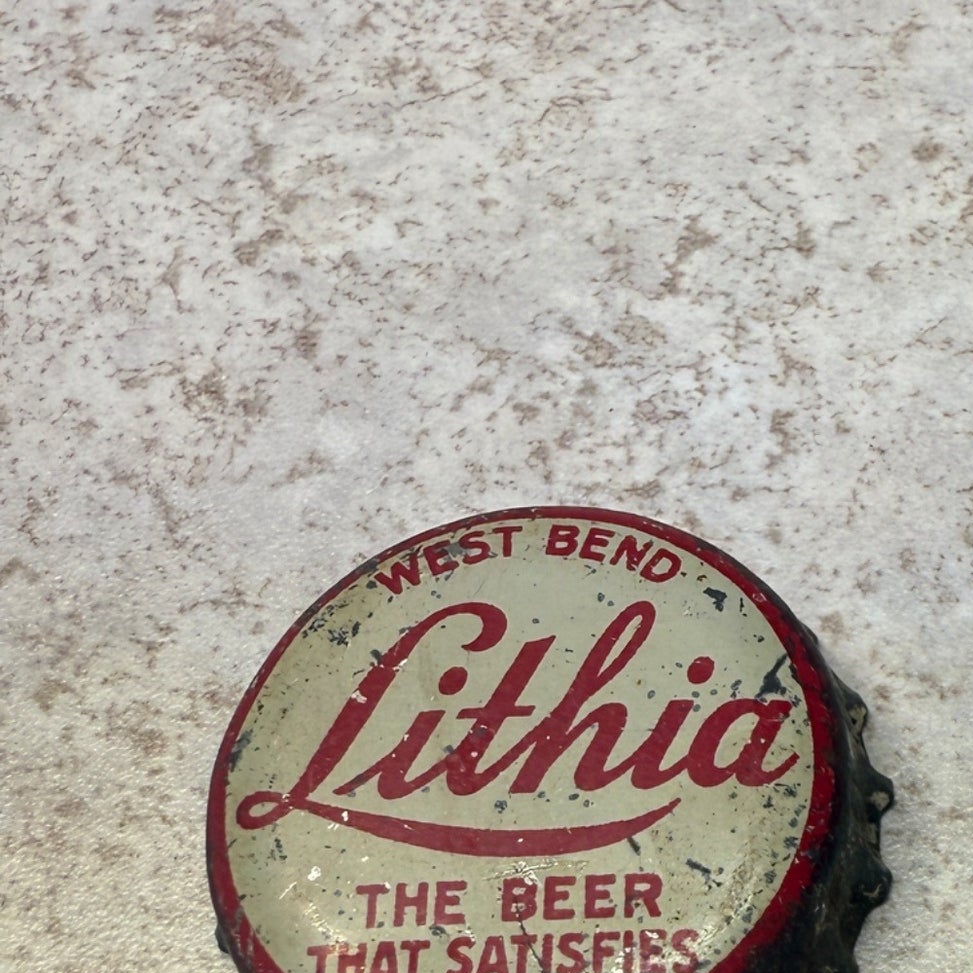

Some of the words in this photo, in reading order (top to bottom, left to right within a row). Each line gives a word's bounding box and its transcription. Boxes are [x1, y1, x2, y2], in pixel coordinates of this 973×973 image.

[373, 525, 522, 595] WEST
[546, 524, 683, 583] BEND
[236, 600, 801, 857] Lithia
[356, 880, 468, 928] THE
[501, 872, 664, 922] BEER
